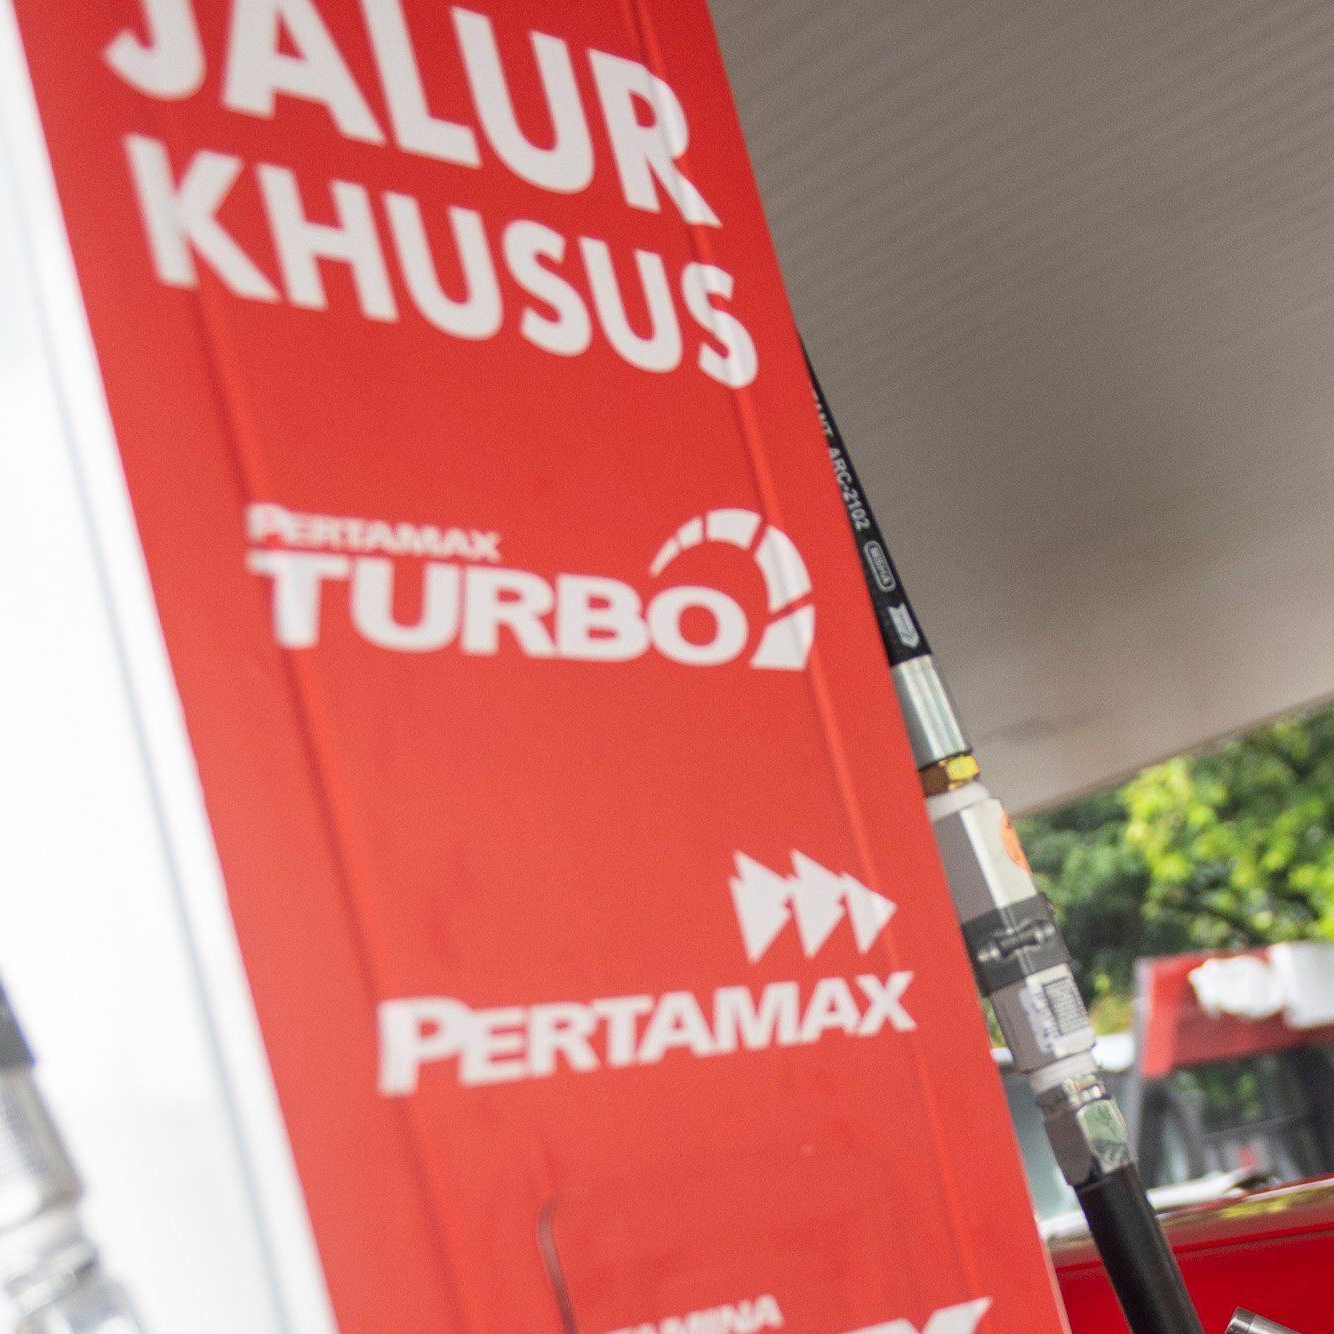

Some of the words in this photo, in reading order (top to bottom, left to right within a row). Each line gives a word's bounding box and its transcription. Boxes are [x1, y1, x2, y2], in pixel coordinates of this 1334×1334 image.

[104, 0, 721, 228] JALUR
[123, 134, 758, 388] KHUSUS
[247, 502, 501, 563] PERTAMAX
[828, 447, 870, 532] ARC-2102
[247, 549, 748, 667] TURBO
[378, 971, 915, 1097] PERTAMAX
